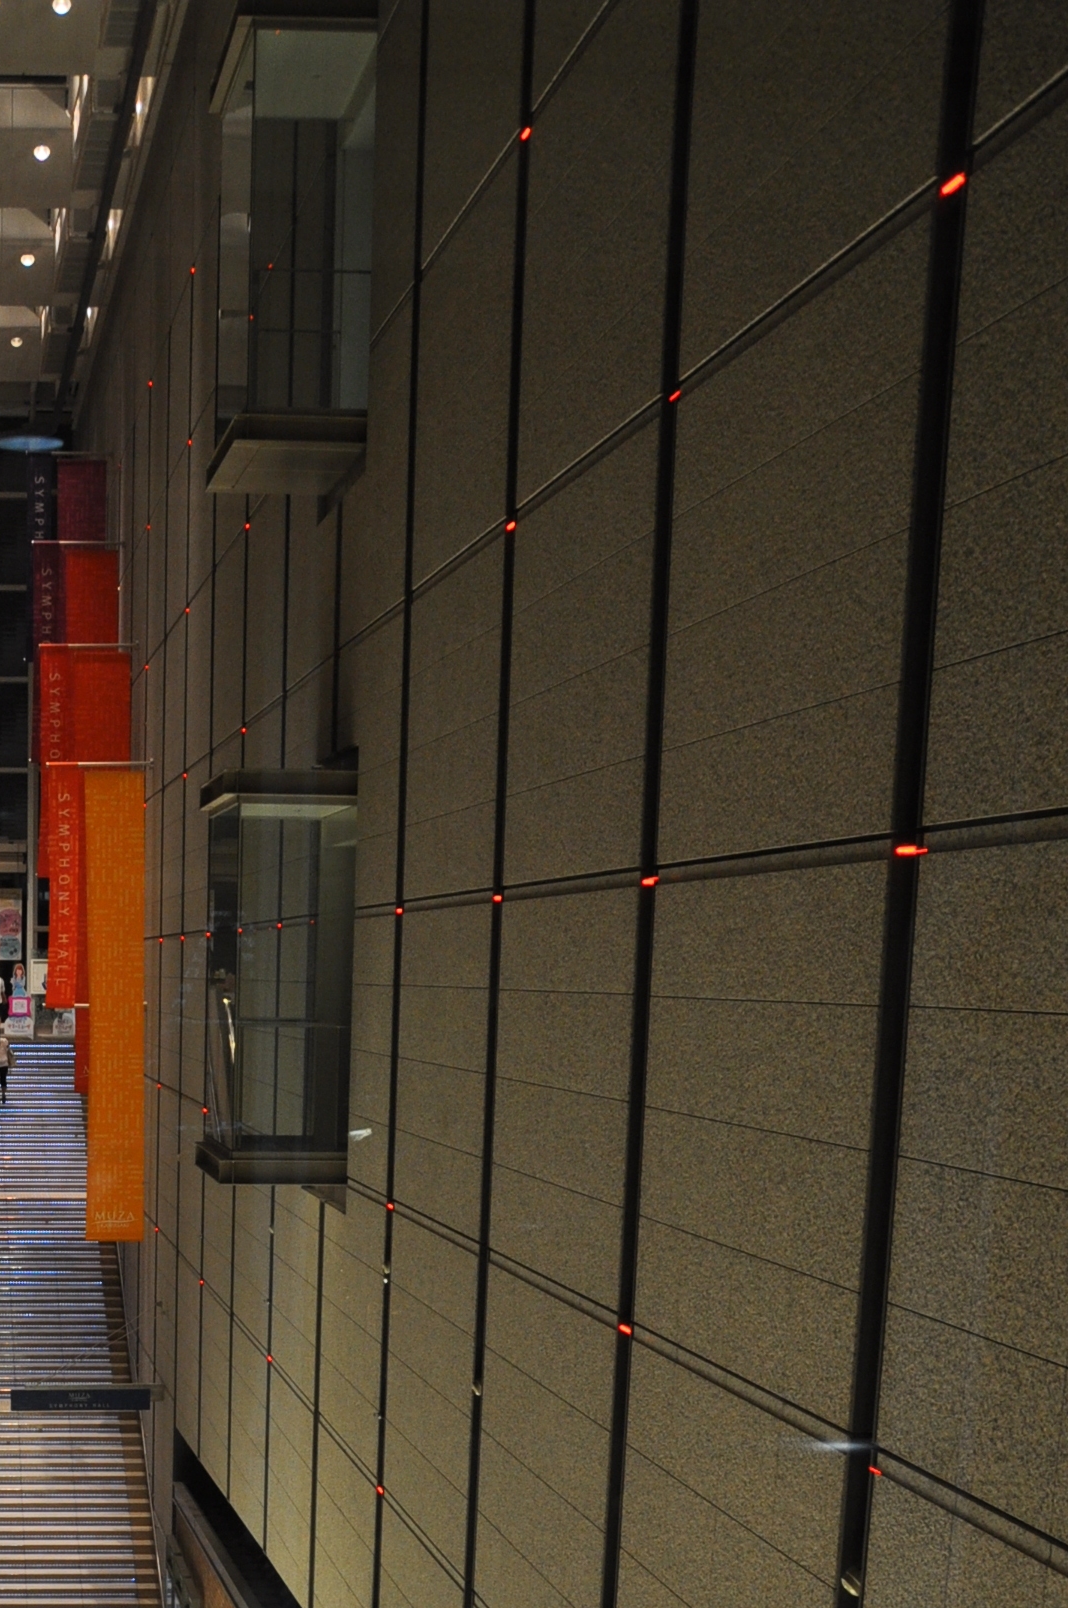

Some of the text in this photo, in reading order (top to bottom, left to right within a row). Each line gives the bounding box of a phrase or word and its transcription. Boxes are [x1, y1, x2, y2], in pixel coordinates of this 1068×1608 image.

[34, 476, 45, 539] SYMPH
[41, 567, 53, 645] SYMPH
[49, 672, 62, 760] SYMPHO
[55, 792, 71, 986] SYMPHONY HALL
[94, 1211, 135, 1221] MUZA
